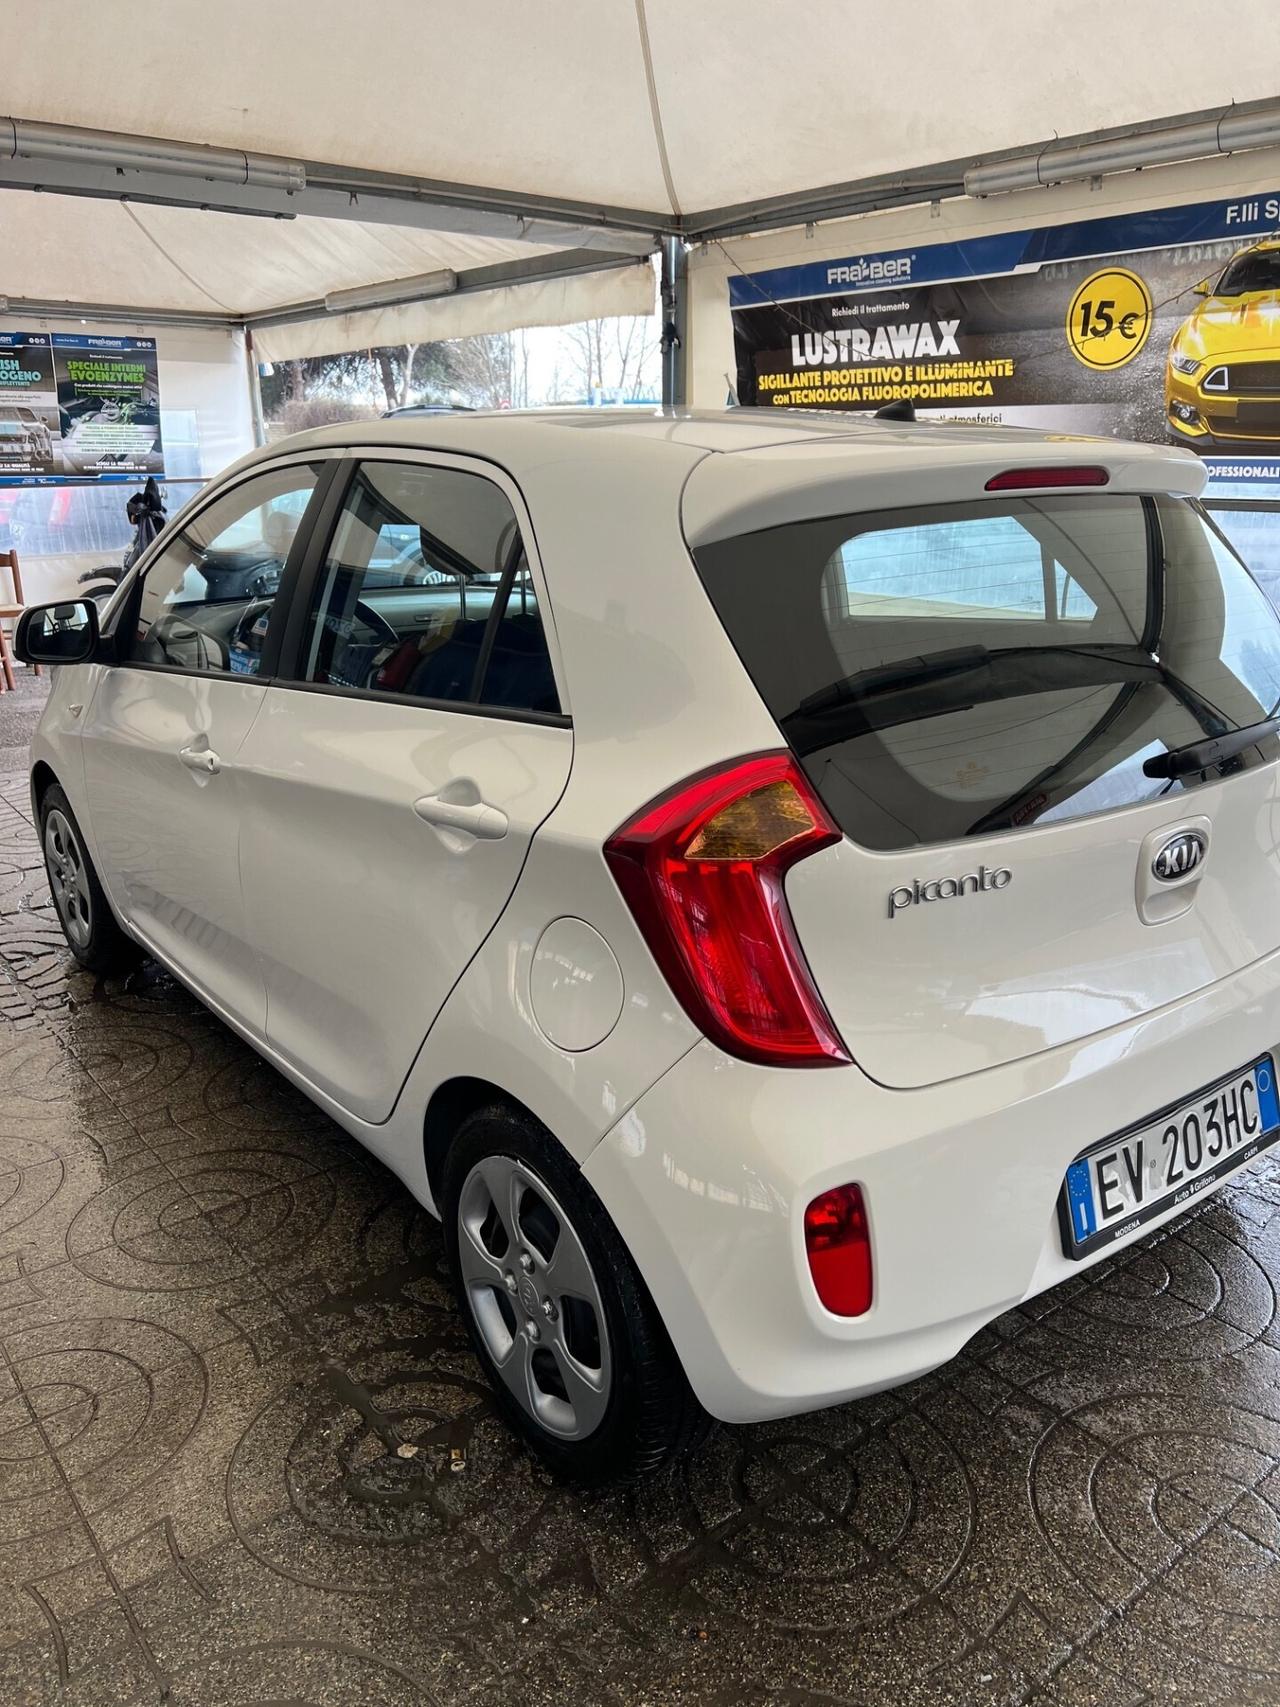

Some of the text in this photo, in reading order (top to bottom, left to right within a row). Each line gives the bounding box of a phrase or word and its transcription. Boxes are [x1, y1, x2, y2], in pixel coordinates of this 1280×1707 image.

[1265, 200, 1280, 222] S
[832, 301, 910, 317] Richiedi il trattamento
[791, 319, 961, 367] LUSTRAWAX
[0, 370, 42, 381] OGENO
[67, 360, 146, 373] SPECIALE INTERNI
[70, 370, 145, 383] EVOENZYMES
[758, 359, 1014, 391] SIGILLANTE PROTETTIVO E ILLUMINANTE
[772, 380, 993, 405] CON TECNOLOGIA FLUOROPOLIMERICA
[1164, 841, 1202, 876] KIA
[887, 865, 1013, 919] picanto
[1096, 1140, 1144, 1220] EV
[1162, 1079, 1258, 1187] 203HC
[1114, 1219, 1141, 1238] MODENA
[1174, 1190, 1190, 1205] Auto
